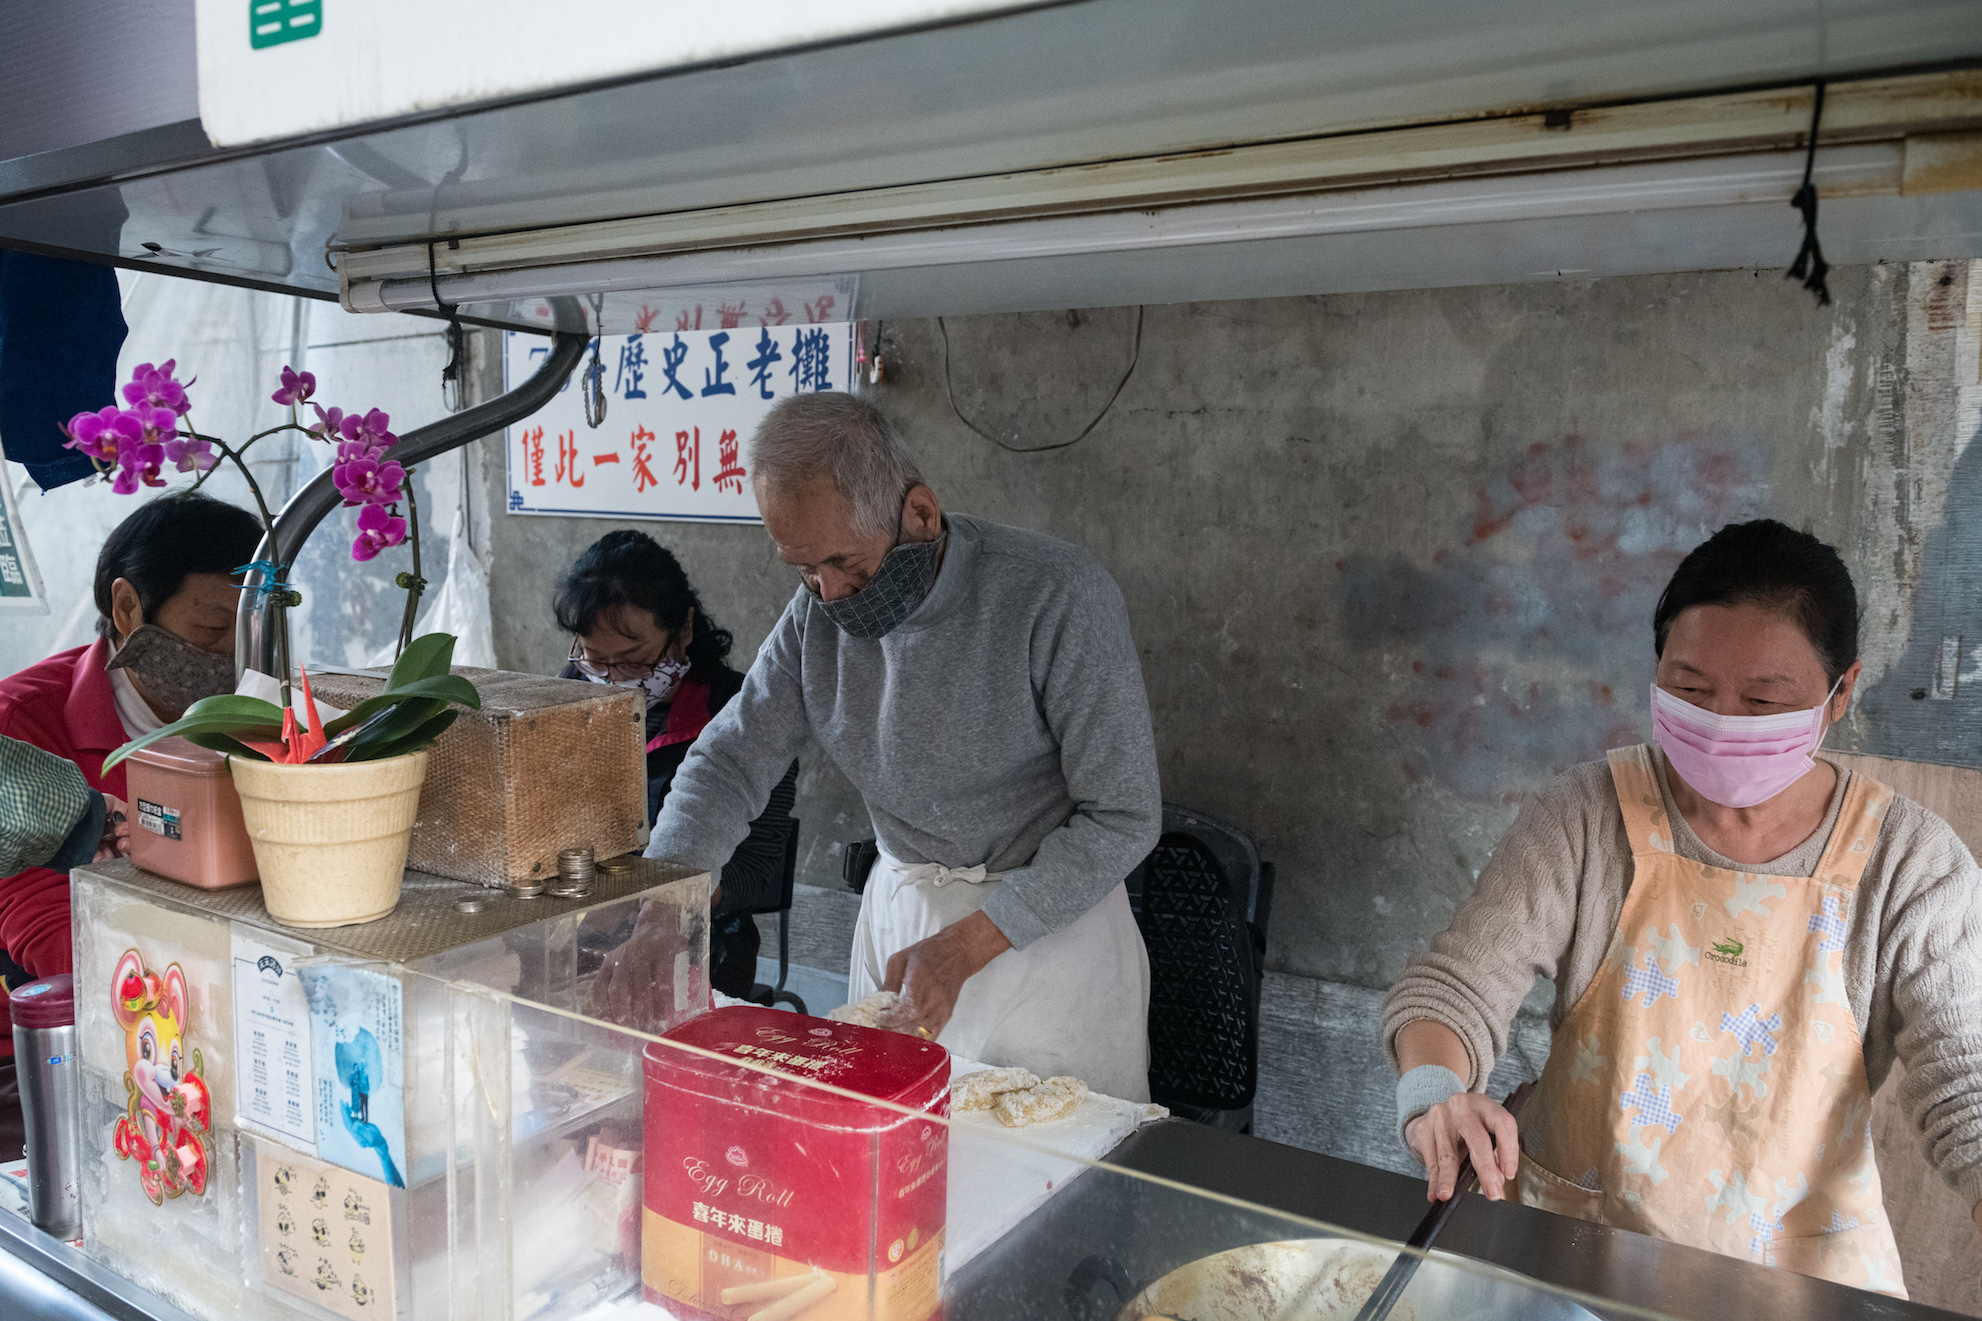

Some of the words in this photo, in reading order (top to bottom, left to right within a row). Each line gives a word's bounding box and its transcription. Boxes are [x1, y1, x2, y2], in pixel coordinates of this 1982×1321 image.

[522, 424, 746, 495] 僅此一家別無
[1704, 951, 1748, 967] Crocodile
[897, 1153, 922, 1176] Egg
[683, 1156, 729, 1197] Egg
[738, 1174, 795, 1208] Roll
[692, 1201, 783, 1247] 喜年來蛋捲
[709, 1249, 743, 1272] DHA
